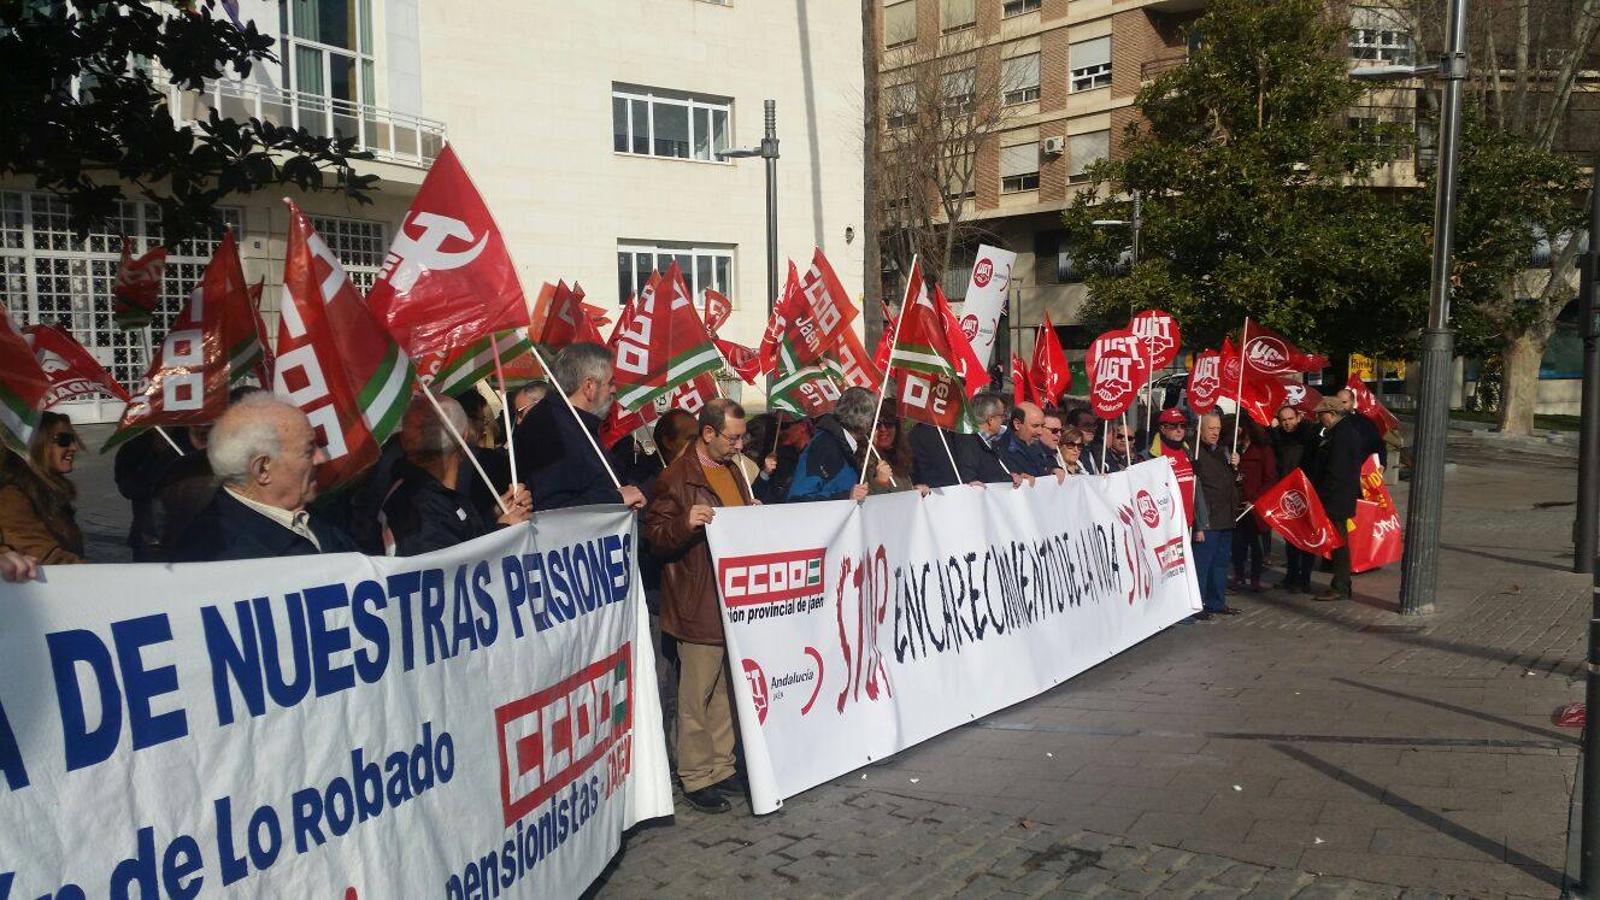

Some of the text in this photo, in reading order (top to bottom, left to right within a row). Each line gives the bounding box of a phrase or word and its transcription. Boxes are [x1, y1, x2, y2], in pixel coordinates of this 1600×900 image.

[1132, 316, 1172, 339] UGT
[1095, 357, 1132, 383] UGT
[1194, 356, 1221, 382] UGT
[748, 602, 795, 625] provincial
[797, 597, 807, 612] de
[45, 612, 189, 773] DE
[200, 560, 499, 727] NUESTRAS
[110, 721, 455, 900] de Lo Robado
[446, 774, 599, 900] pensionistas
